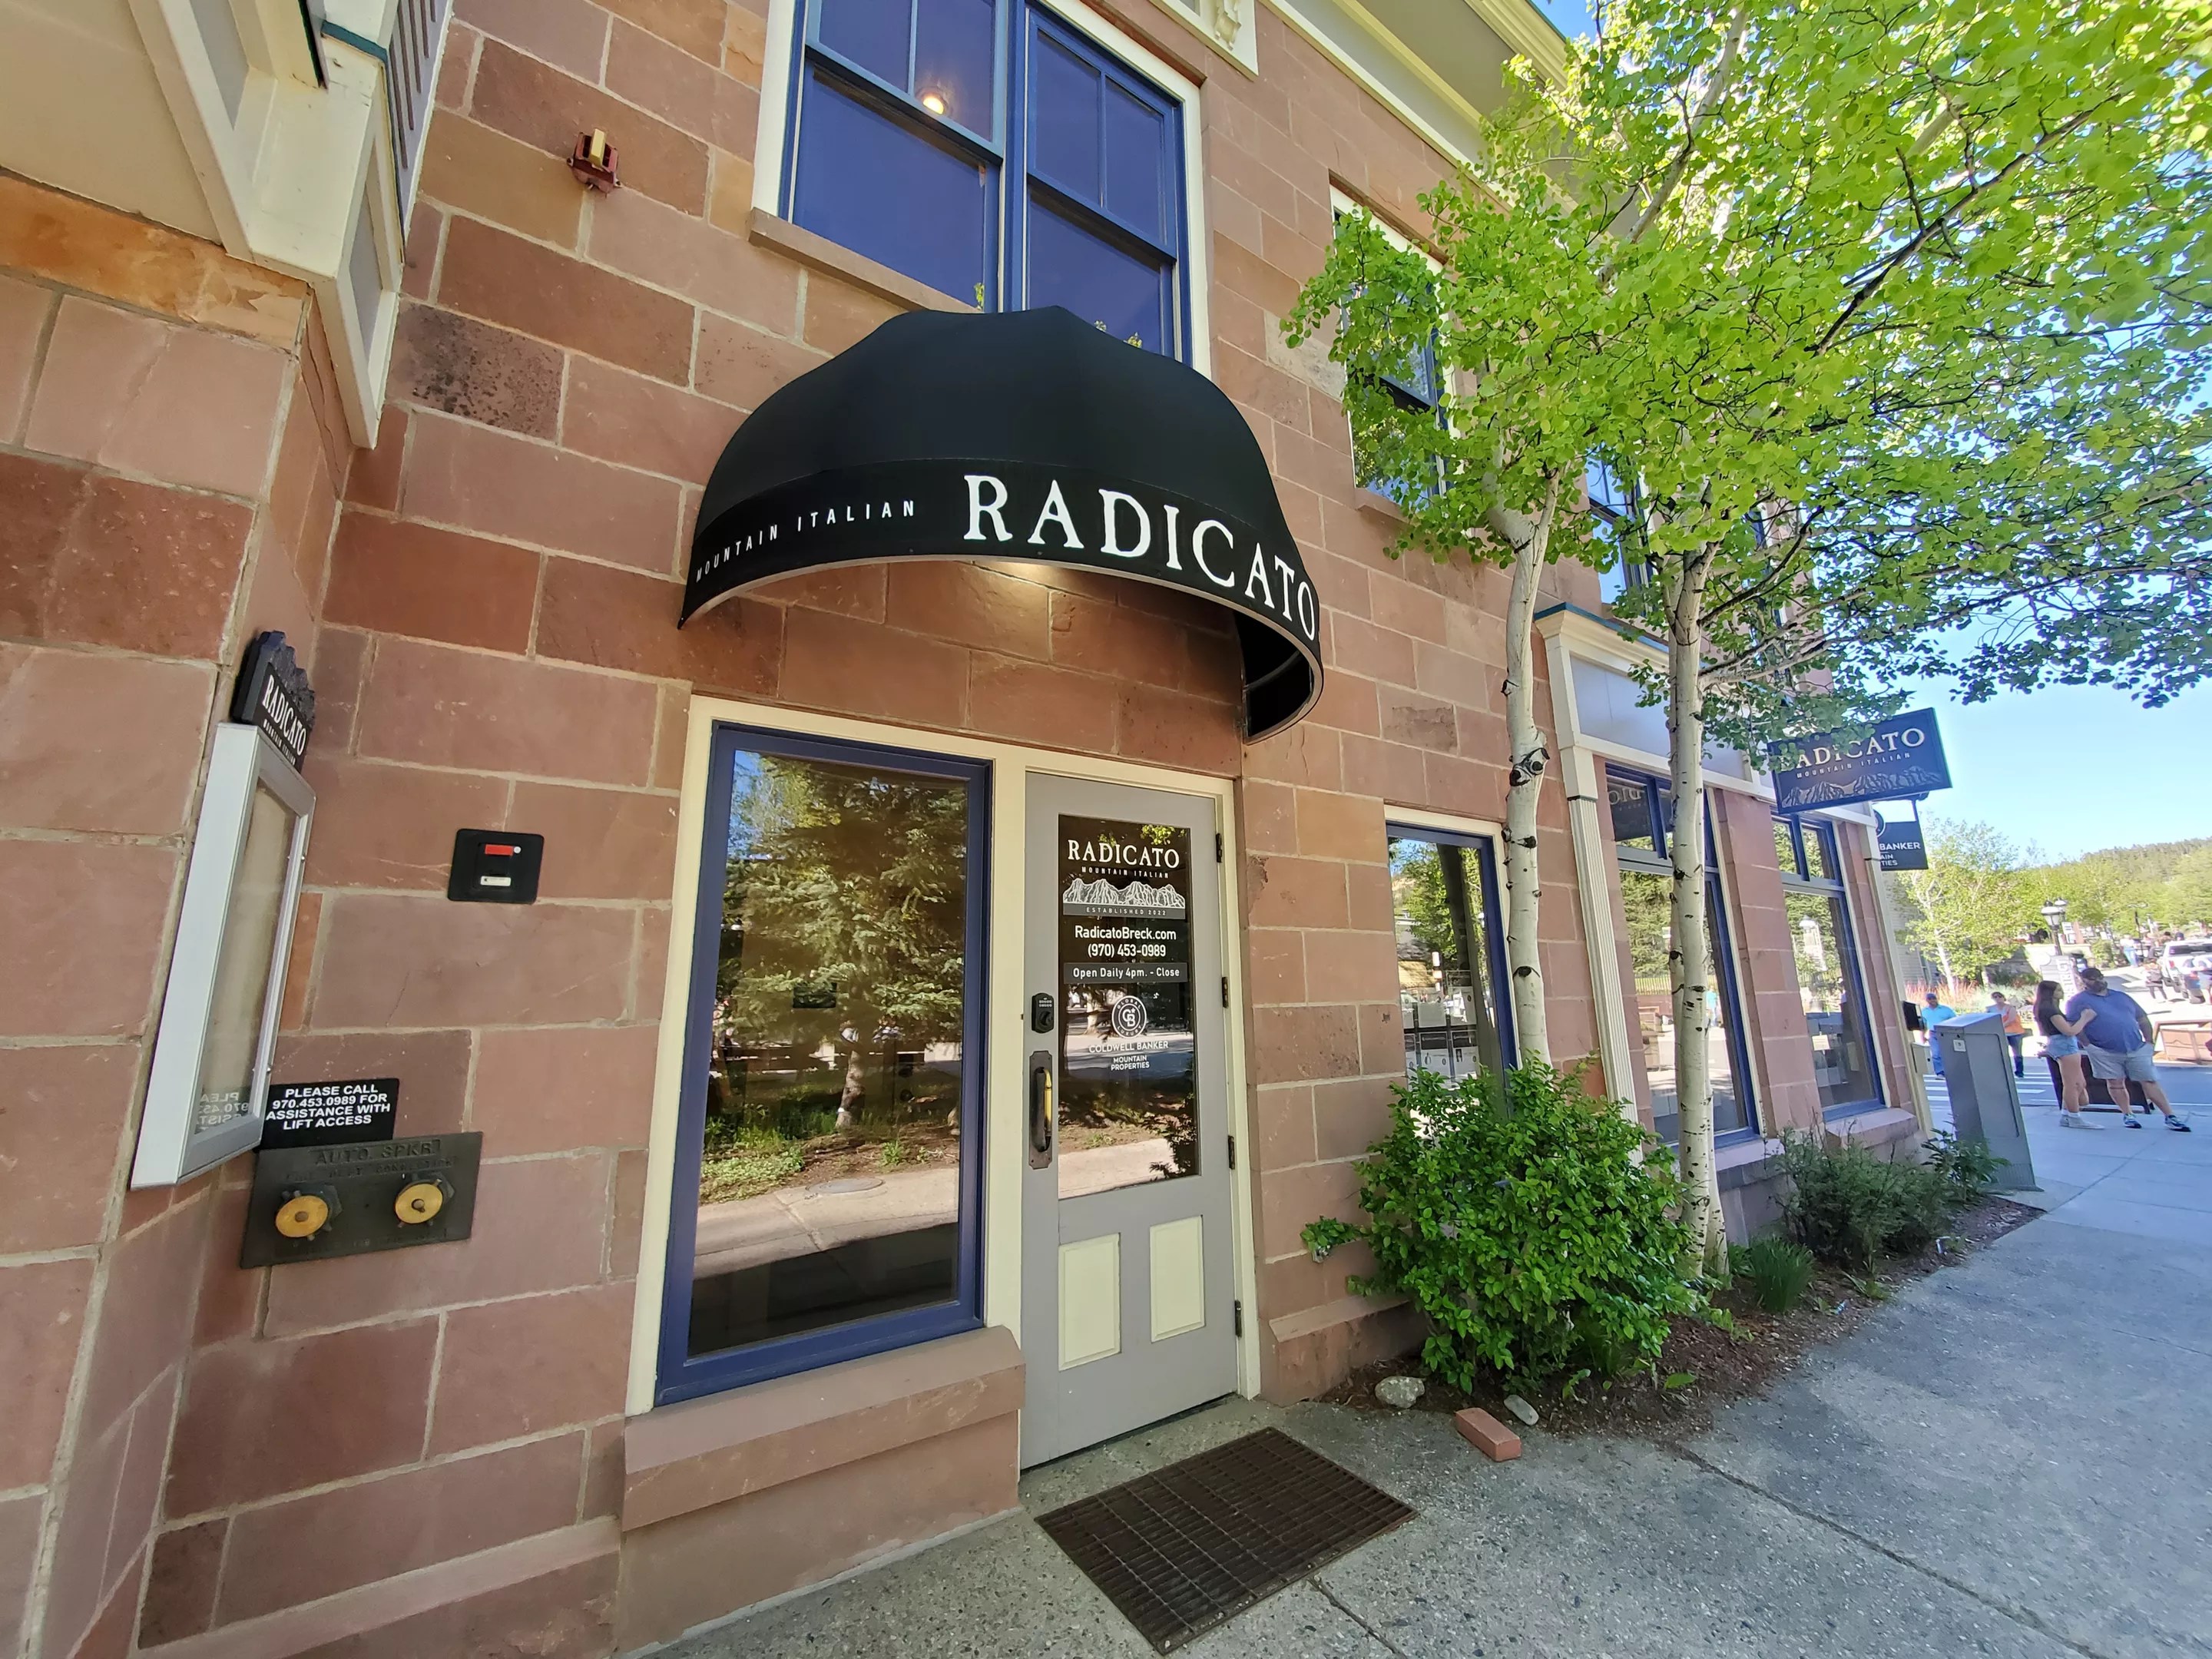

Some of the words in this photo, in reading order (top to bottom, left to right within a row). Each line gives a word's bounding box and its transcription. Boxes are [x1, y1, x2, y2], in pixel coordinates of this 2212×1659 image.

[696, 524, 778, 582] MOUNTAIN
[796, 500, 914, 532] ITALIAN
[963, 475, 1315, 641] RADICATO
[262, 674, 306, 756] RADICATO
[1796, 763, 1852, 778] MOUNTAIN
[1861, 752, 1911, 767] ITALIAN
[1879, 842, 1921, 850] BANKER
[1068, 839, 1180, 869] RADICATO
[1081, 866, 1128, 876] MOUNTAIN
[1134, 870, 1169, 879] ITALIAN
[1075, 925, 1177, 940] RadicatoBreck.com
[1088, 943, 1114, 958] (970)
[1117, 944, 1167, 957] 453-0989
[1073, 968, 1098, 979] Open
[1100, 968, 1124, 979] Daily
[1125, 968, 1147, 979] 4pm.
[1156, 967, 1180, 977] Close
[1117, 998, 1141, 1010] GLOBAL
[1117, 1025, 1142, 1036] LUXURY
[1089, 1043, 1134, 1053] COLDWELL
[1137, 1041, 1169, 1051] BANKER
[1111, 1061, 1150, 1071] PROPERTIES
[1113, 1055, 1147, 1064] MOUNTAIN
[285, 1087, 339, 1098] PLEASE
[343, 1084, 379, 1095] CALL
[273, 1096, 356, 1109] 970.453.0989
[359, 1094, 388, 1104] FOR
[266, 1106, 353, 1121] ASSISTANCE
[356, 1104, 391, 1114] WITH
[283, 1119, 313, 1130] LIFT
[315, 1114, 372, 1128] ACCESS
